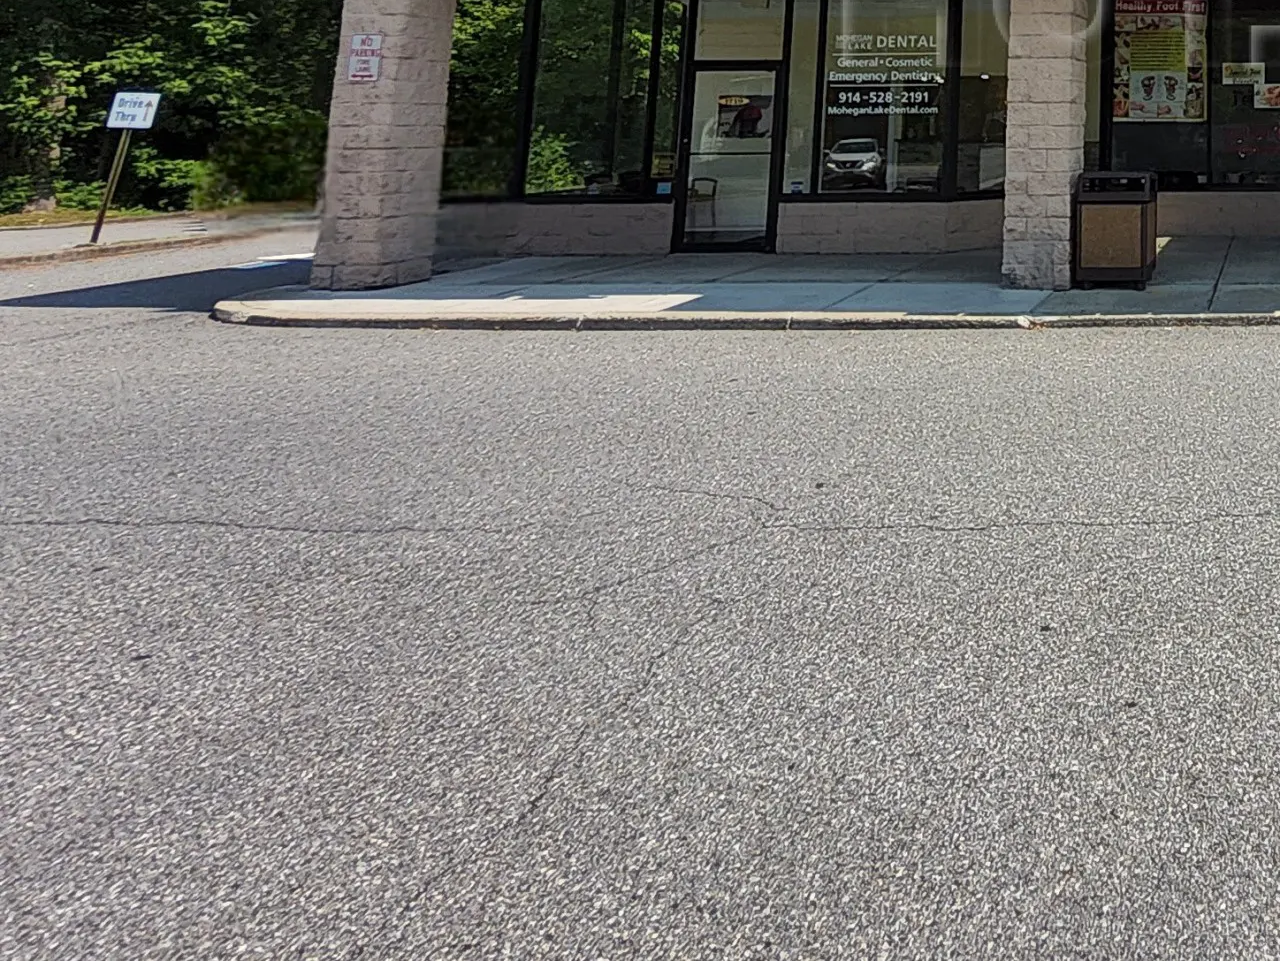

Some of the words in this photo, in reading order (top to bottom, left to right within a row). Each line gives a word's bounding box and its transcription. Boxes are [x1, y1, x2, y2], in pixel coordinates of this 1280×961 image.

[1115, 0, 1152, 13] Healthy
[1157, 0, 1179, 11] Foot
[1182, 0, 1205, 13] First
[361, 37, 373, 47] NO
[848, 41, 873, 50] LAKE
[876, 35, 937, 48] DENTAL
[350, 49, 381, 57] PARKING
[837, 57, 878, 67] General
[885, 57, 933, 67] Cosmetic
[829, 71, 887, 83] Emergency
[891, 71, 940, 82] Dentistry
[118, 98, 144, 108] Drive
[827, 105, 939, 116] MoheganLakeDental.com
